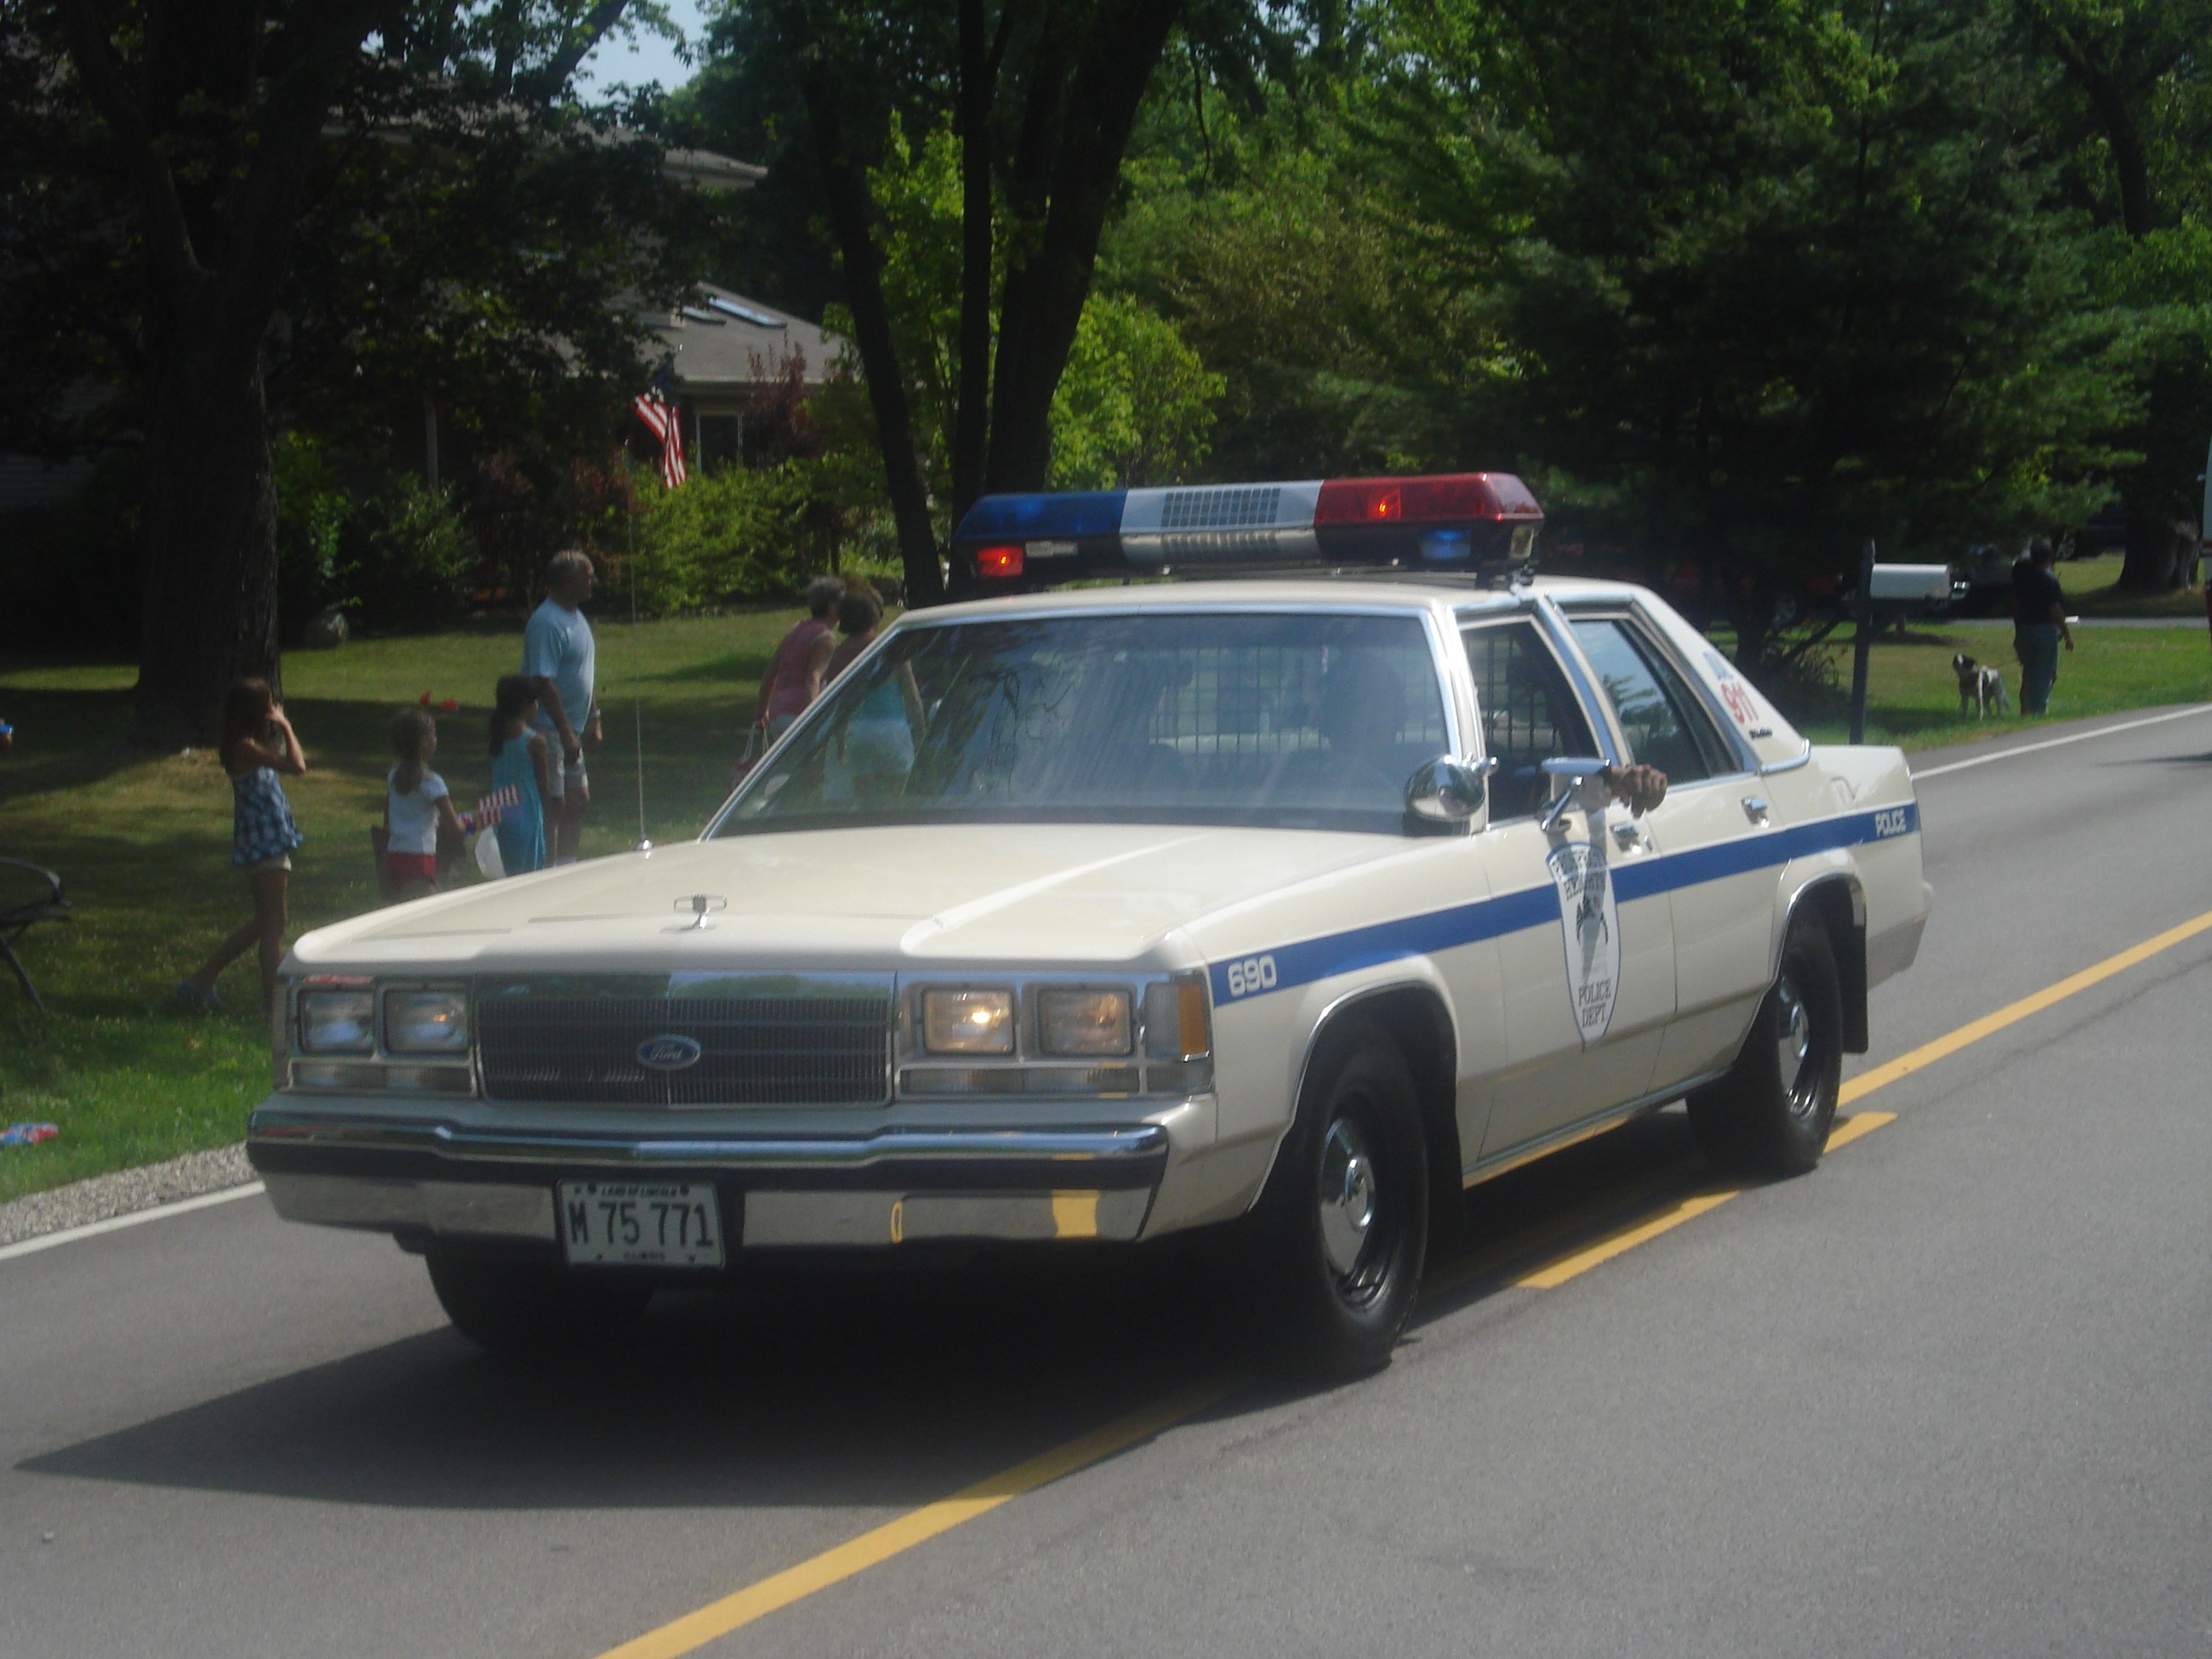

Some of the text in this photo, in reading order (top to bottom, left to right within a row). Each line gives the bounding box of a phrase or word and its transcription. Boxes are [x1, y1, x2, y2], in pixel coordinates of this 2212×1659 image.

[1875, 808, 1907, 837] POLICE
[1228, 955, 1278, 997] 690
[1578, 979, 1611, 1007] POLICE
[649, 1042, 684, 1062] Ford
[568, 1202, 714, 1246] M 75 771
